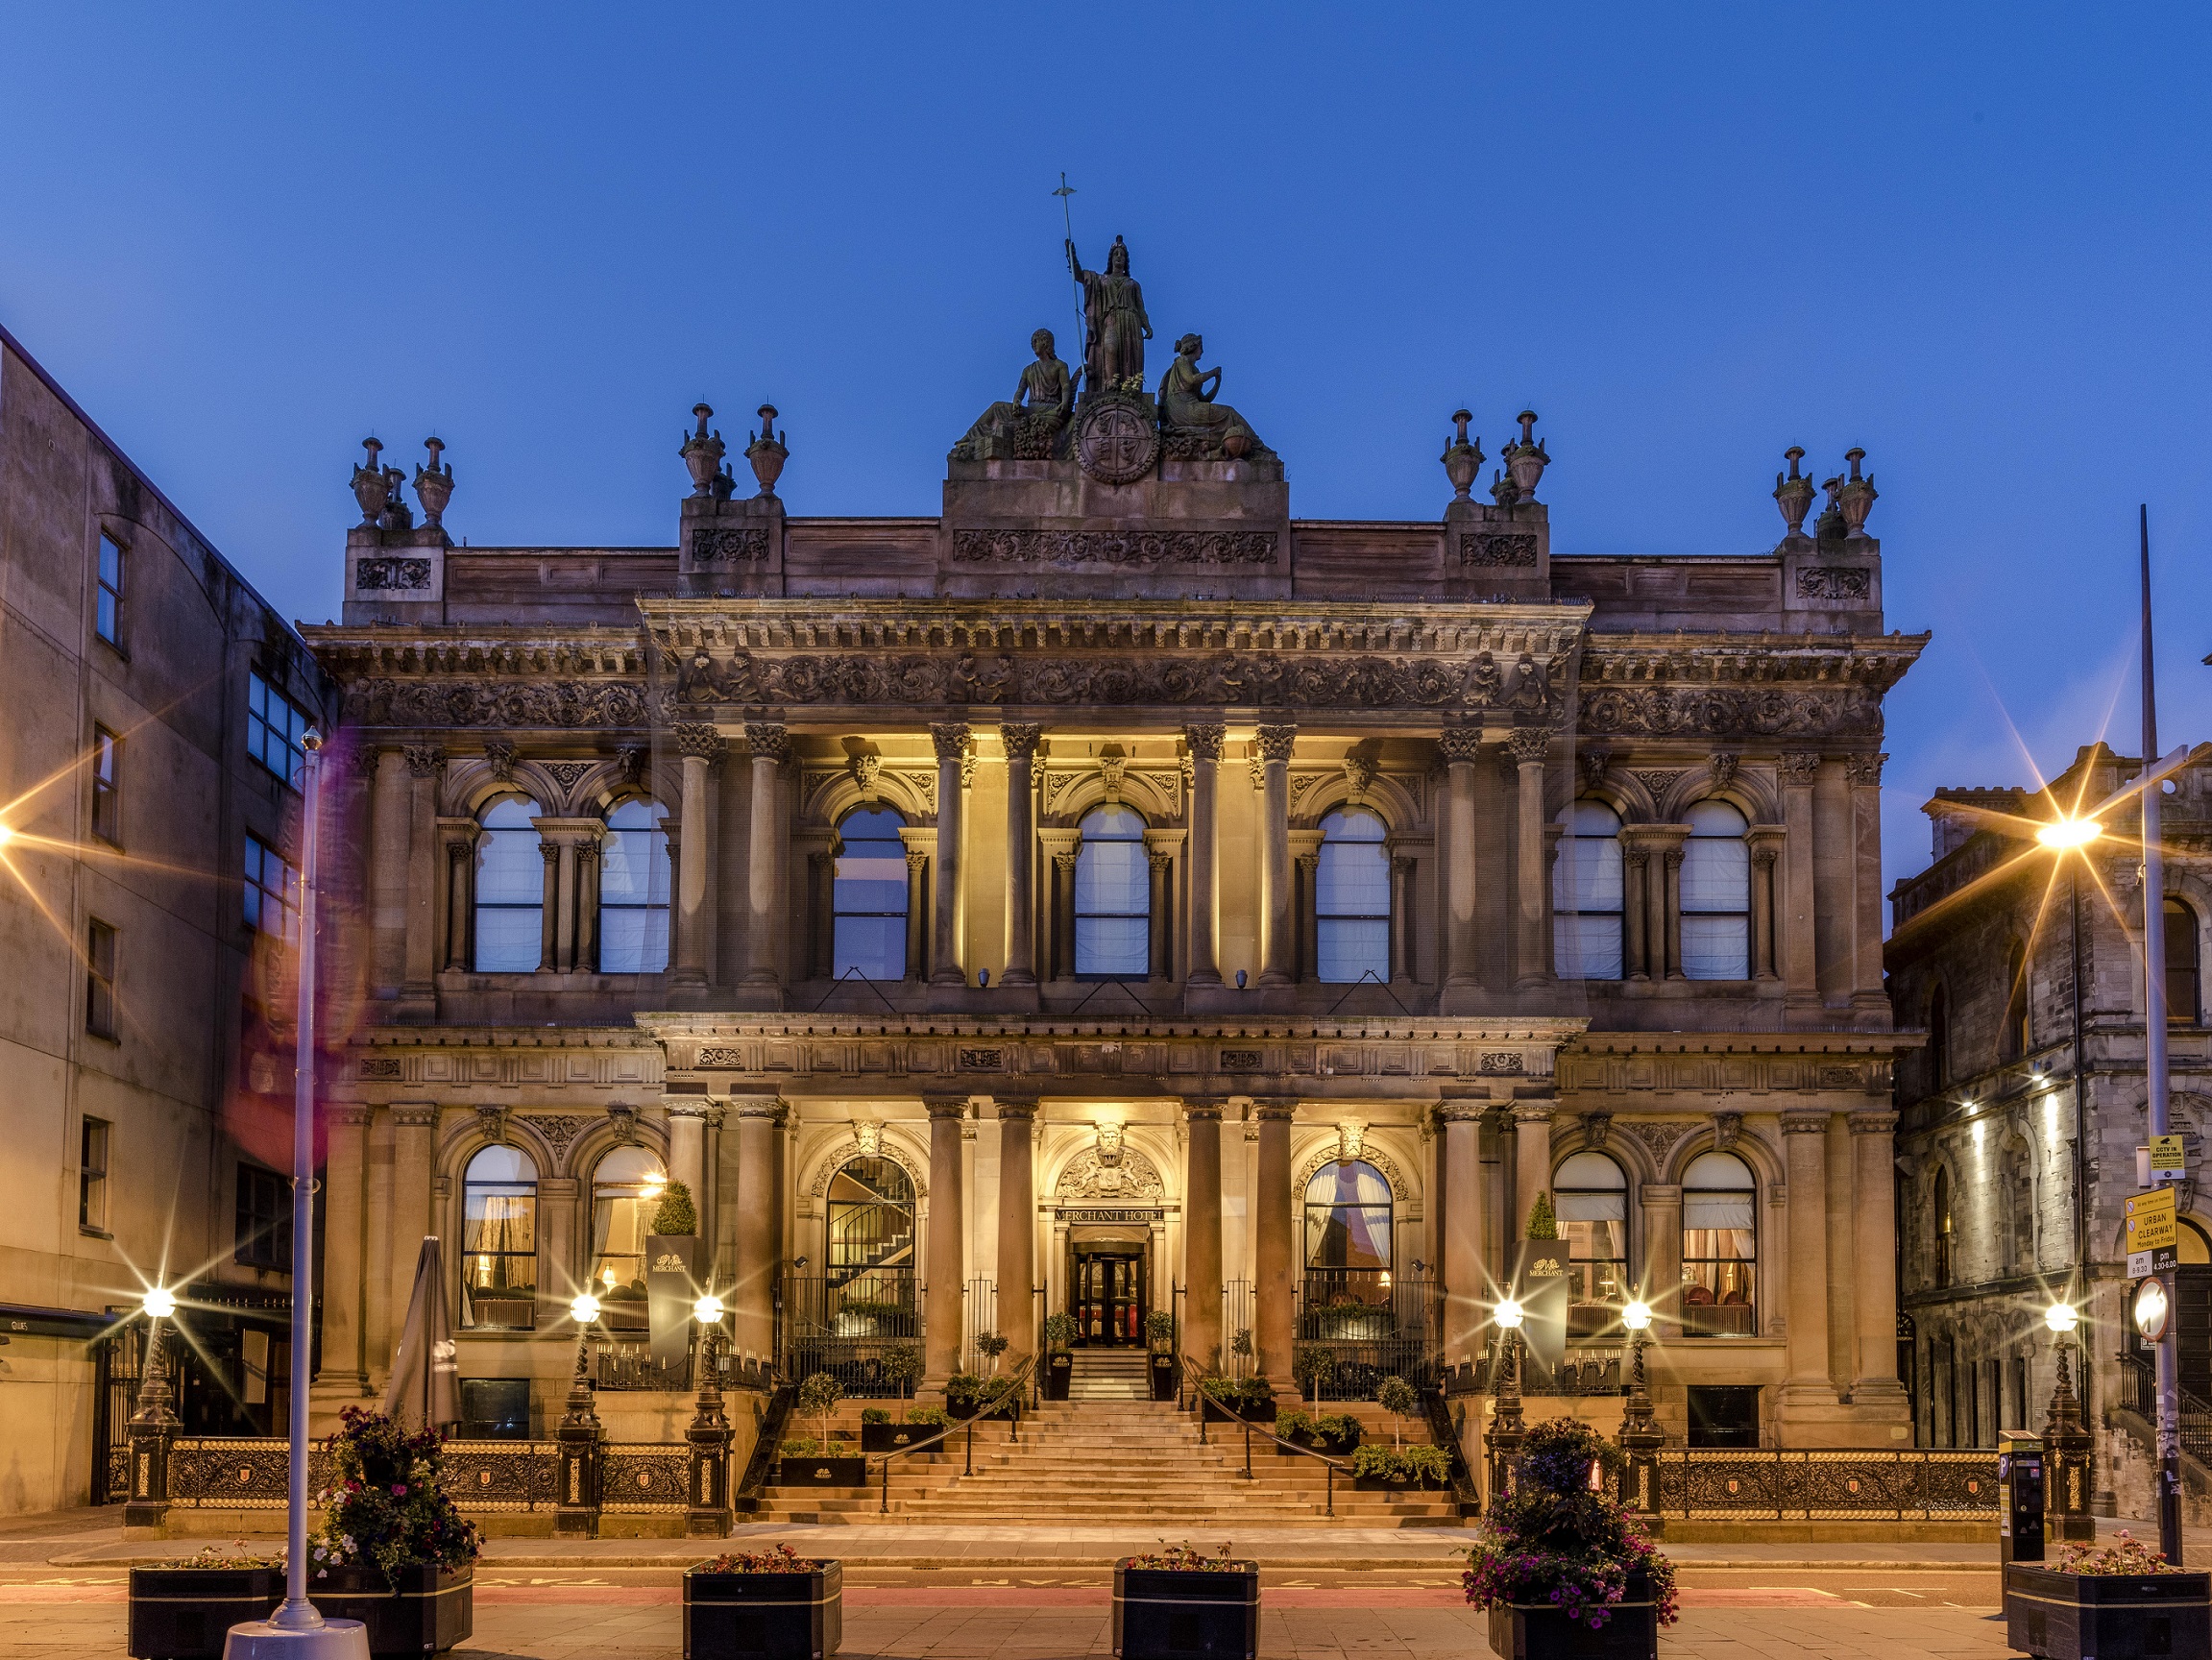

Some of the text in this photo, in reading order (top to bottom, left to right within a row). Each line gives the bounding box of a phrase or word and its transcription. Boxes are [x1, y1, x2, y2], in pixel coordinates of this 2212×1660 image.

[1055, 1210, 1164, 1221] MERCHANT HOTEL
[2143, 1213, 2167, 1226] URBAN
[2138, 1224, 2174, 1239] CLEARWAY
[2137, 1238, 2154, 1249] Monday
[2160, 1235, 2176, 1244] Friday
[2159, 1252, 2170, 1262] pm
